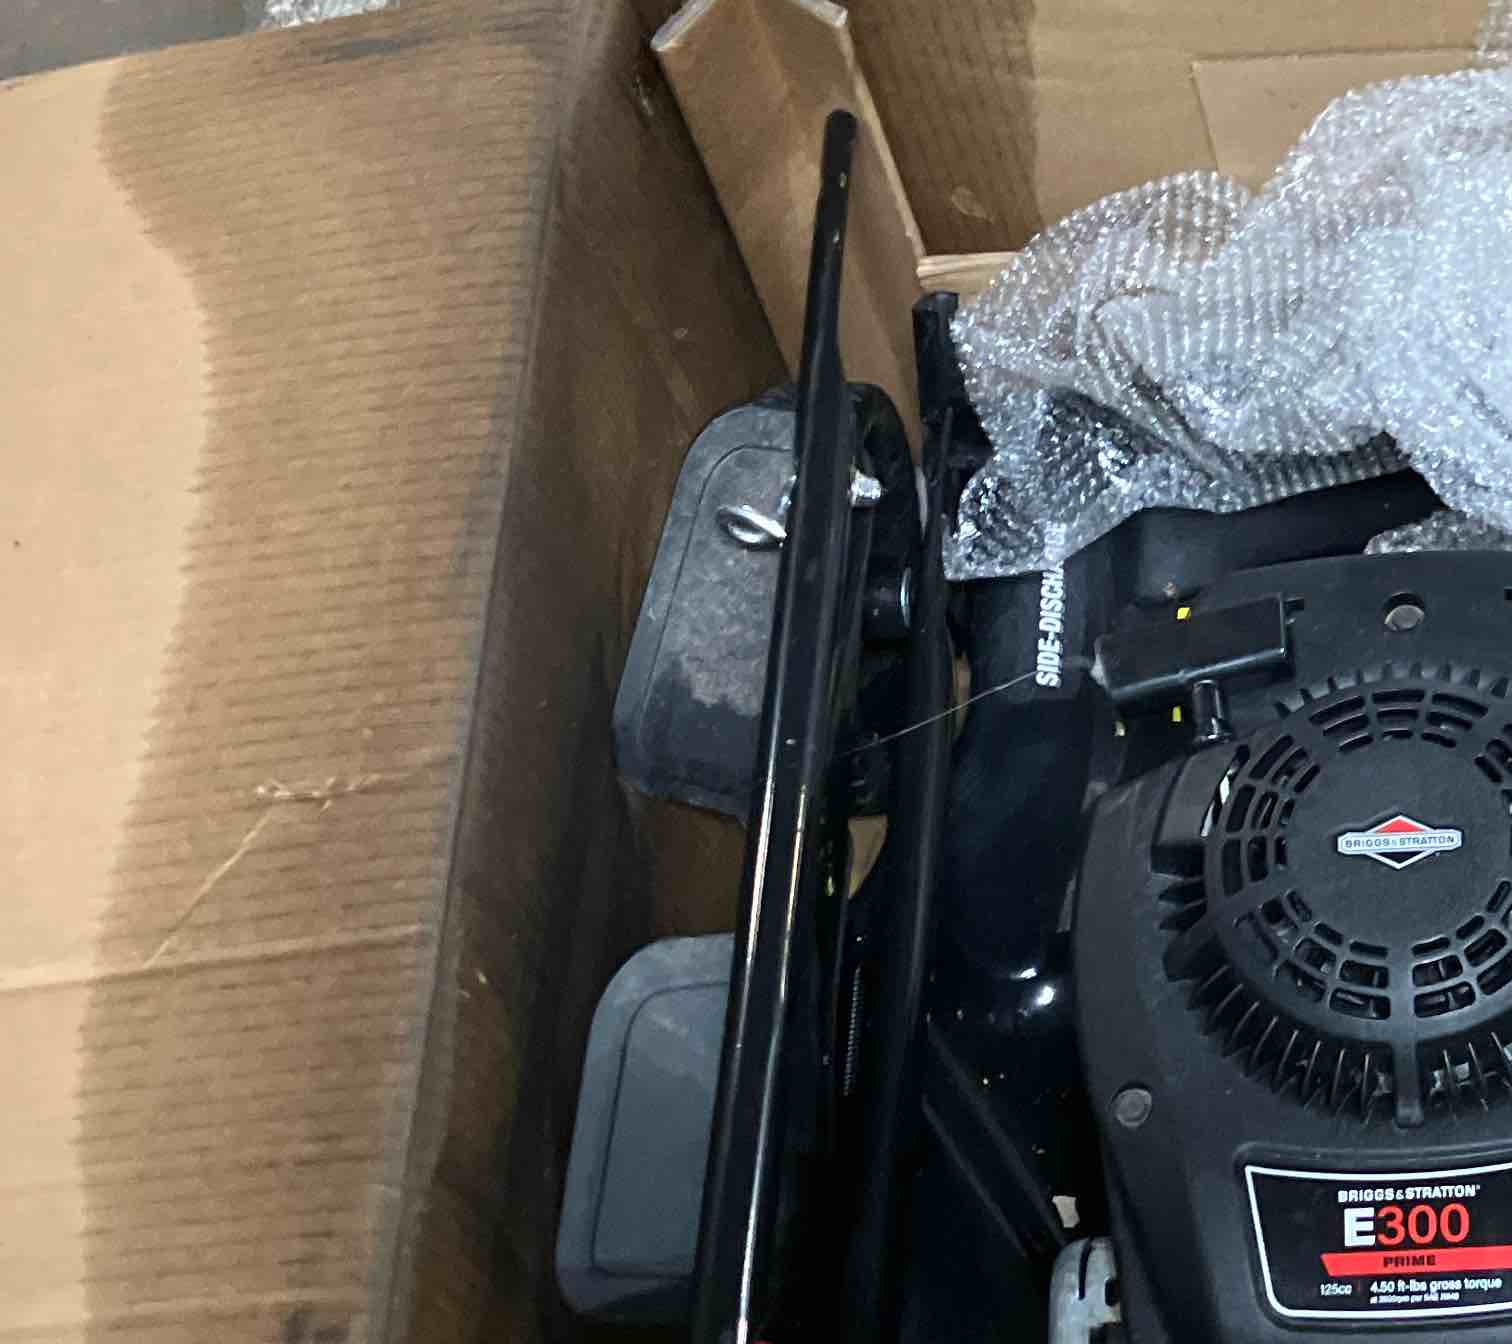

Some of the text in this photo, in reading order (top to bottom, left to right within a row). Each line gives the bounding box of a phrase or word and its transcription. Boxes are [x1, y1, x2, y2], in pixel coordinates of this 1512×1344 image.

[1344, 1202, 1471, 1247] E300
[1383, 1253, 1436, 1268] PRIME
[1319, 1283, 1352, 1296] 125cc
[1429, 1278, 1462, 1293] gross
[1464, 1277, 1502, 1292] torque
